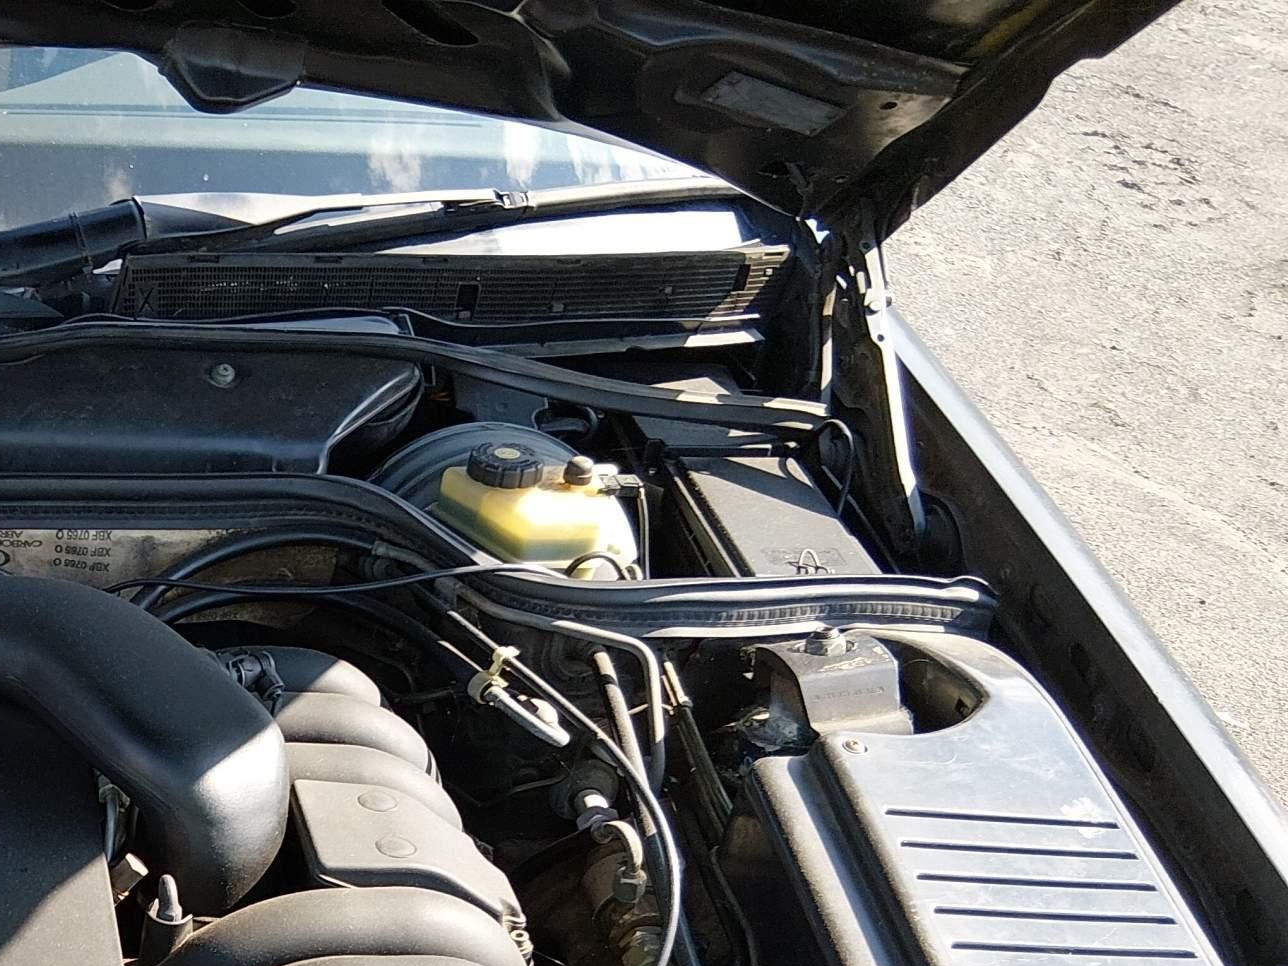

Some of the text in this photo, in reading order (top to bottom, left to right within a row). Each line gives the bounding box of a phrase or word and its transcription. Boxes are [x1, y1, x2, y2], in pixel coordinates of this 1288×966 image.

[66, 530, 90, 541] 0765
[91, 530, 112, 541] XBF
[65, 545, 89, 556] 0765
[90, 547, 111, 558] XBF
